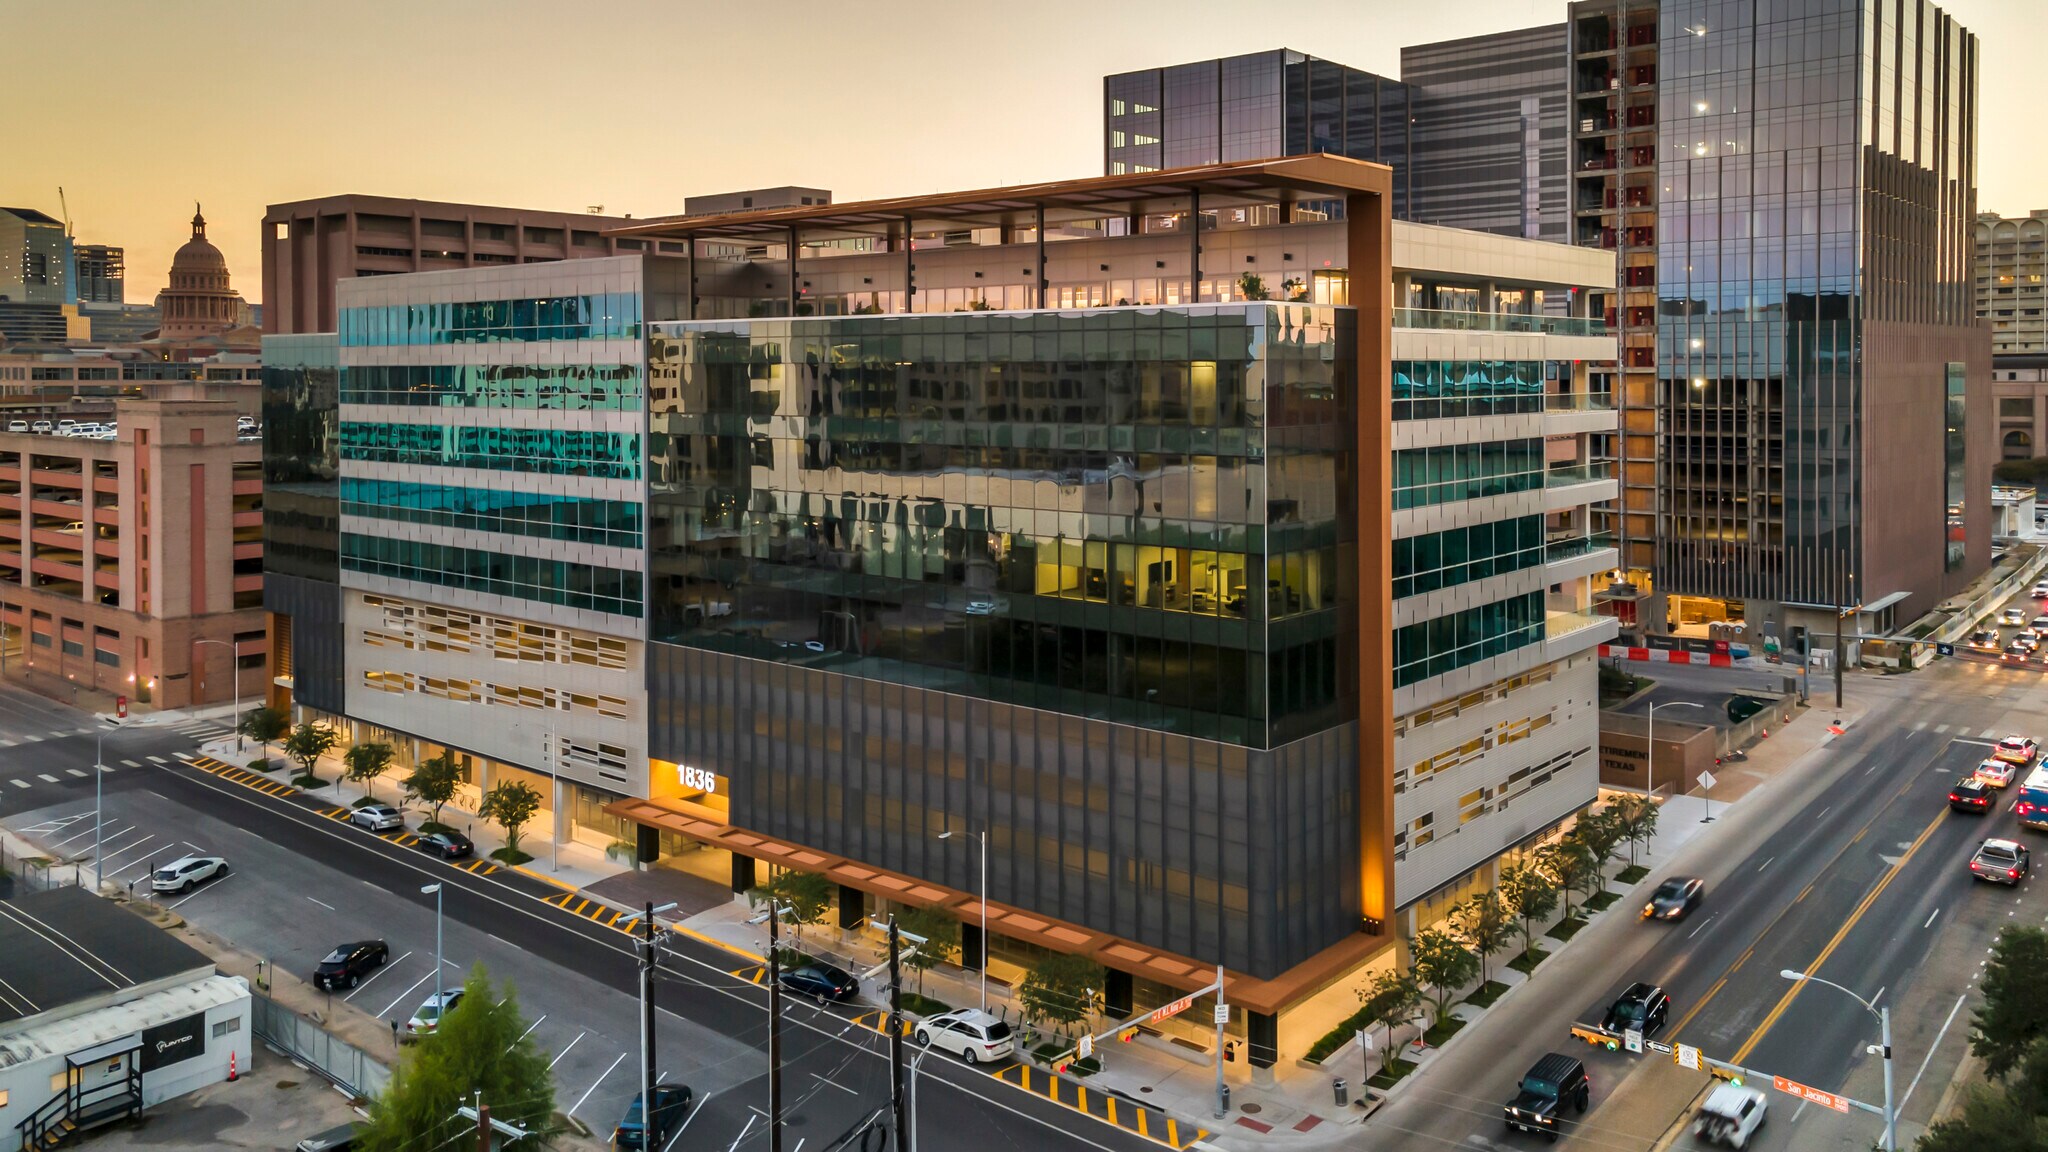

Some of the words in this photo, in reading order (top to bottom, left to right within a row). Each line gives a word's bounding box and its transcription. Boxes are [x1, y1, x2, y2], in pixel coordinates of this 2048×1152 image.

[1605, 759, 1635, 772] TEXAS
[677, 764, 715, 793] 1836
[1787, 1082, 1801, 1095] San
[1803, 1088, 1831, 1105] Jacinto
